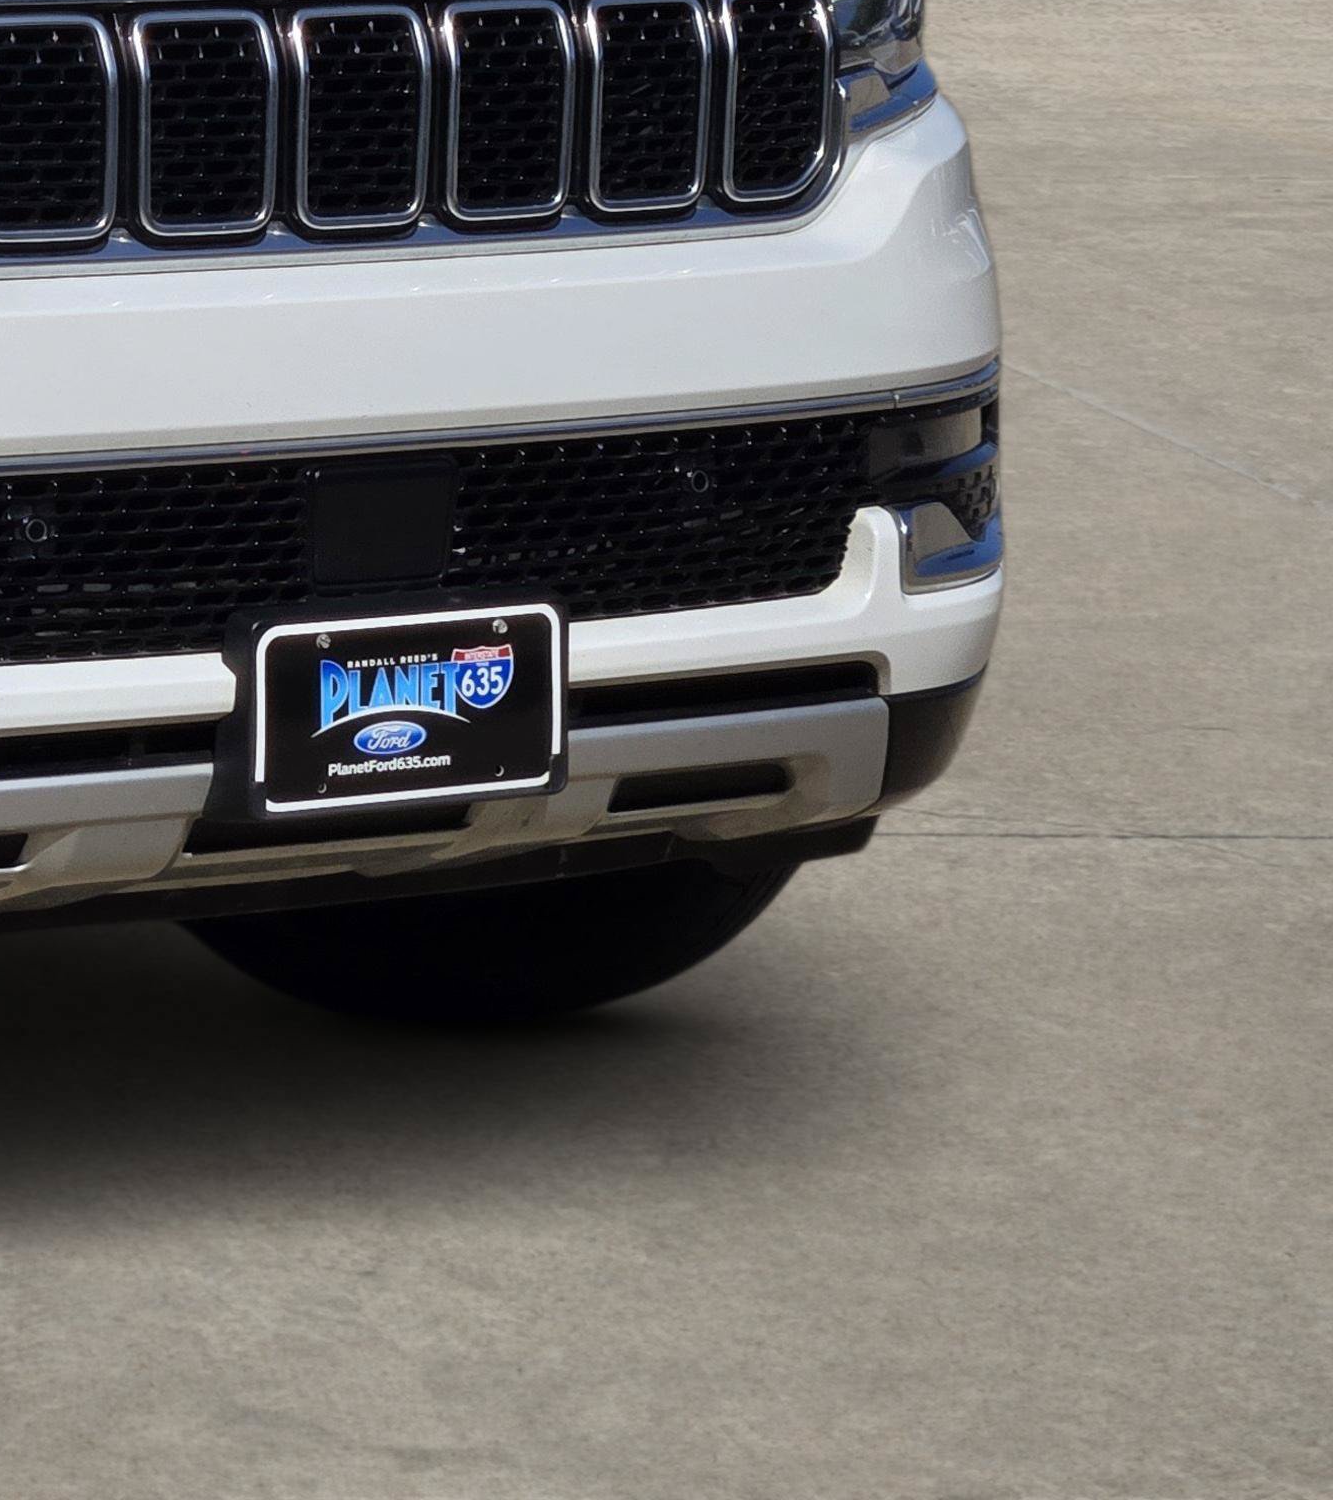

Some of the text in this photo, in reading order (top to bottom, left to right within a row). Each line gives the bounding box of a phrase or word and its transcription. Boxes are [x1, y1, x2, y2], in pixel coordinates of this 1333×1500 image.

[347, 656, 396, 669] RANDALL
[461, 666, 504, 698] 635
[321, 659, 459, 732] PLANET
[368, 726, 411, 750] Ford
[328, 755, 451, 776] PlanetFord635.com
